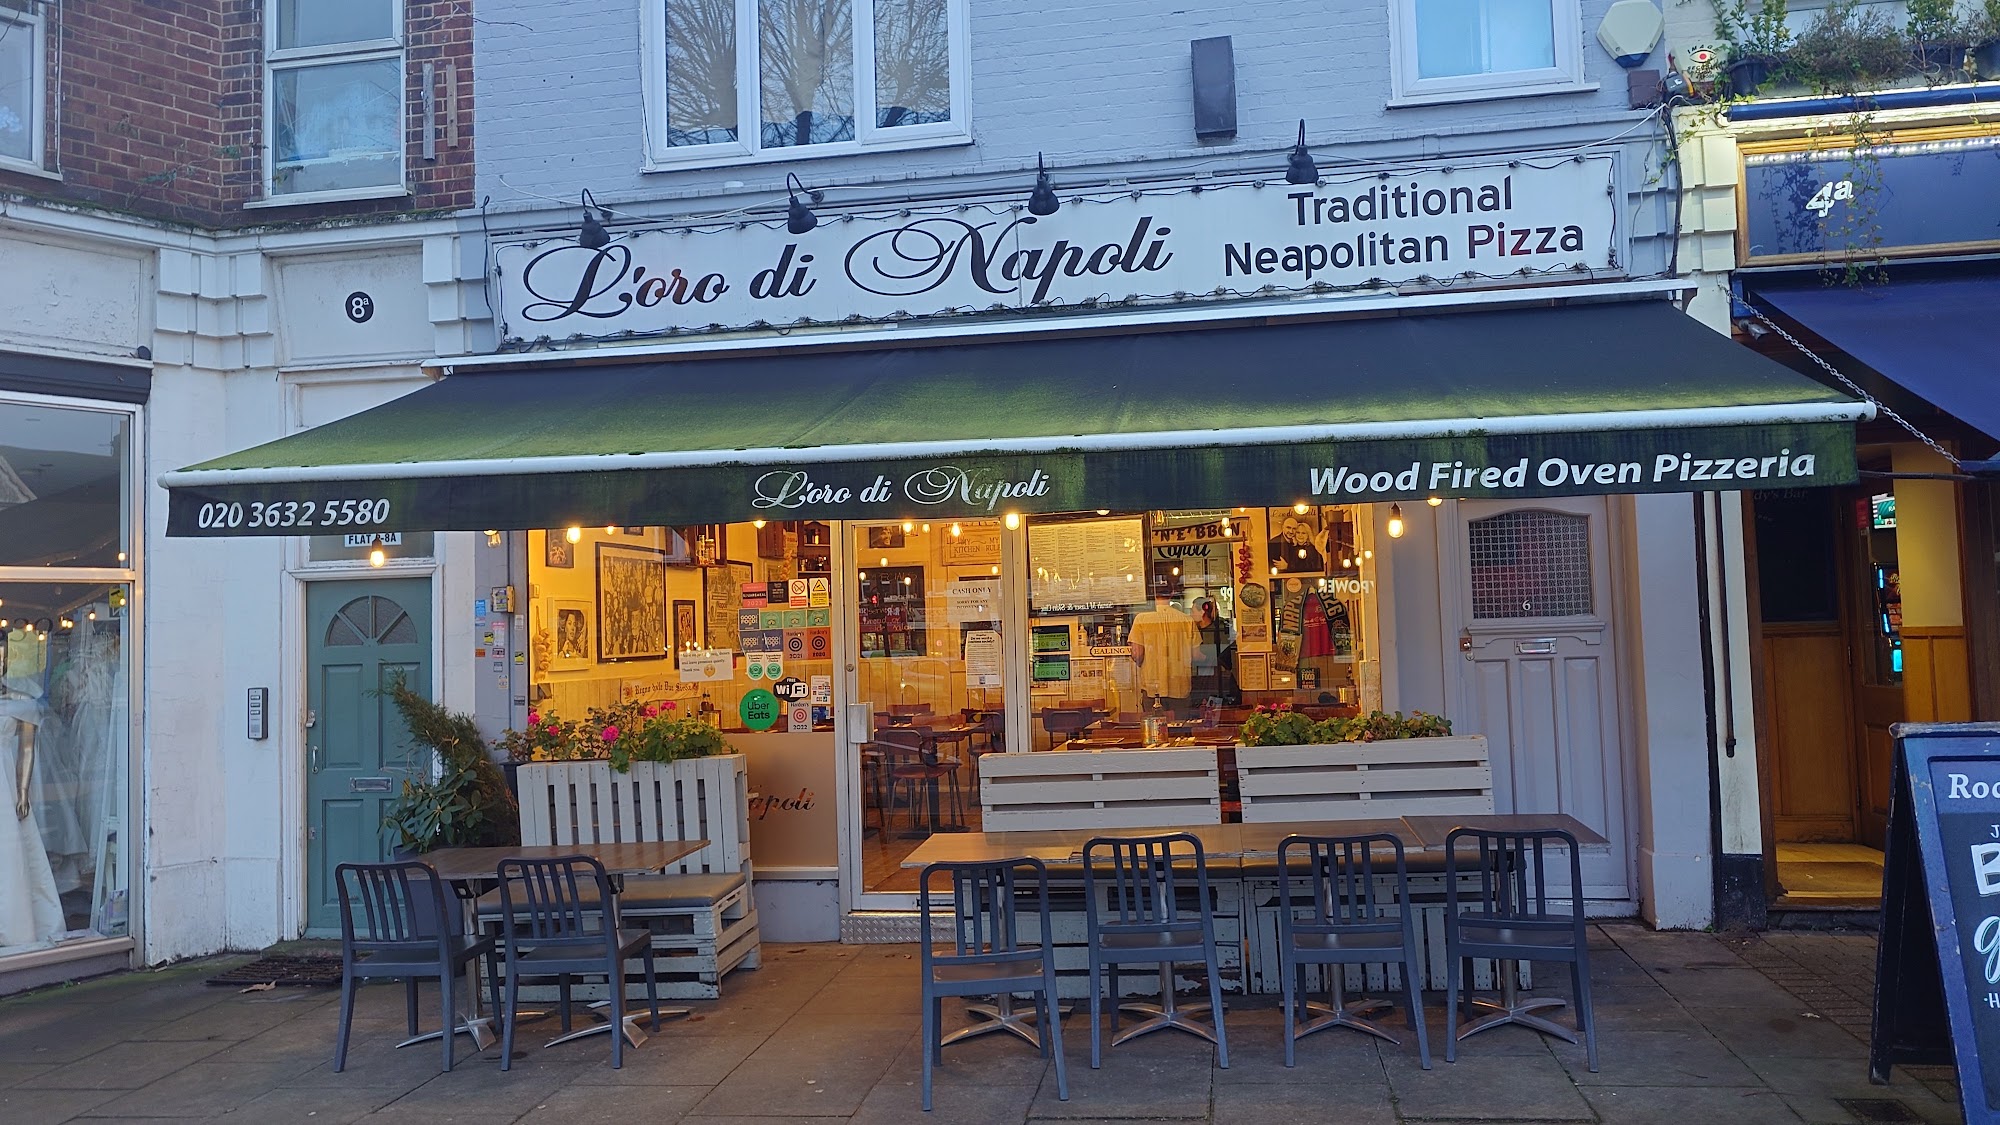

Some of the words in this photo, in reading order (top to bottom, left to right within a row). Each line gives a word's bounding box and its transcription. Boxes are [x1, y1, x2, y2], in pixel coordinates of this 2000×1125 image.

[1287, 176, 1513, 226] Traditional
[1806, 180, 1854, 217] 4a
[1225, 229, 1449, 280] Neapolitan
[1468, 222, 1584, 259] Pizza
[521, 244, 730, 322] L'oro
[749, 243, 817, 298] di
[844, 215, 1174, 304] Napoli
[1310, 461, 1421, 496] Wood
[1428, 457, 1528, 491] Fired
[1537, 456, 1641, 489] Oven
[1653, 448, 1815, 483] Pizzeria
[752, 469, 852, 509] L'oro
[860, 475, 893, 503] di
[904, 466, 1050, 511] Napoli
[198, 502, 244, 529] 020
[248, 500, 315, 528] 3632
[320, 498, 390, 527] 5580
[349, 534, 371, 544] FLAT
[952, 587, 970, 595] CASH
[972, 586, 992, 594] ONLY
[1522, 600, 1531, 610] 6
[1094, 647, 1125, 655] EALING
[748, 702, 770, 710] Uber
[748, 711, 770, 720] Eats
[748, 787, 815, 821] apoli
